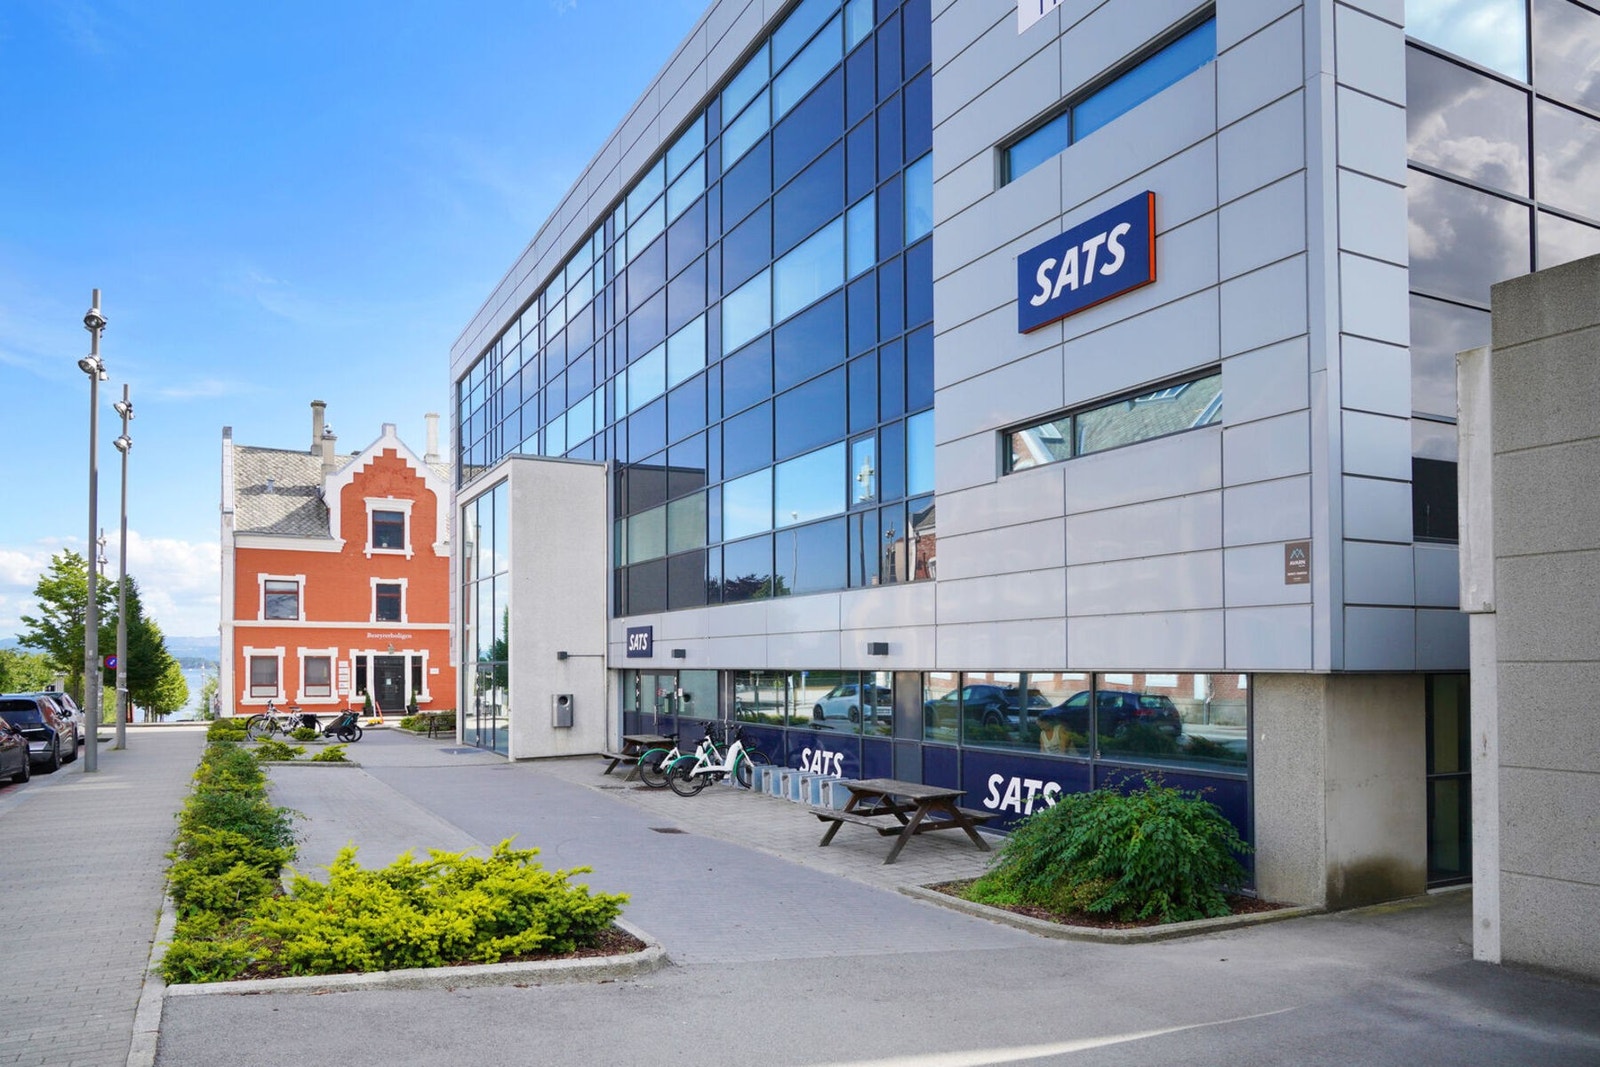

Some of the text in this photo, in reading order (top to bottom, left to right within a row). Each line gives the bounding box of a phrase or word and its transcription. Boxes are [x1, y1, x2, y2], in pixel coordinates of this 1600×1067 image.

[1030, 222, 1131, 306] SATS
[629, 633, 648, 651] SATS
[800, 747, 844, 778] SATS
[983, 773, 1061, 815] SATS
